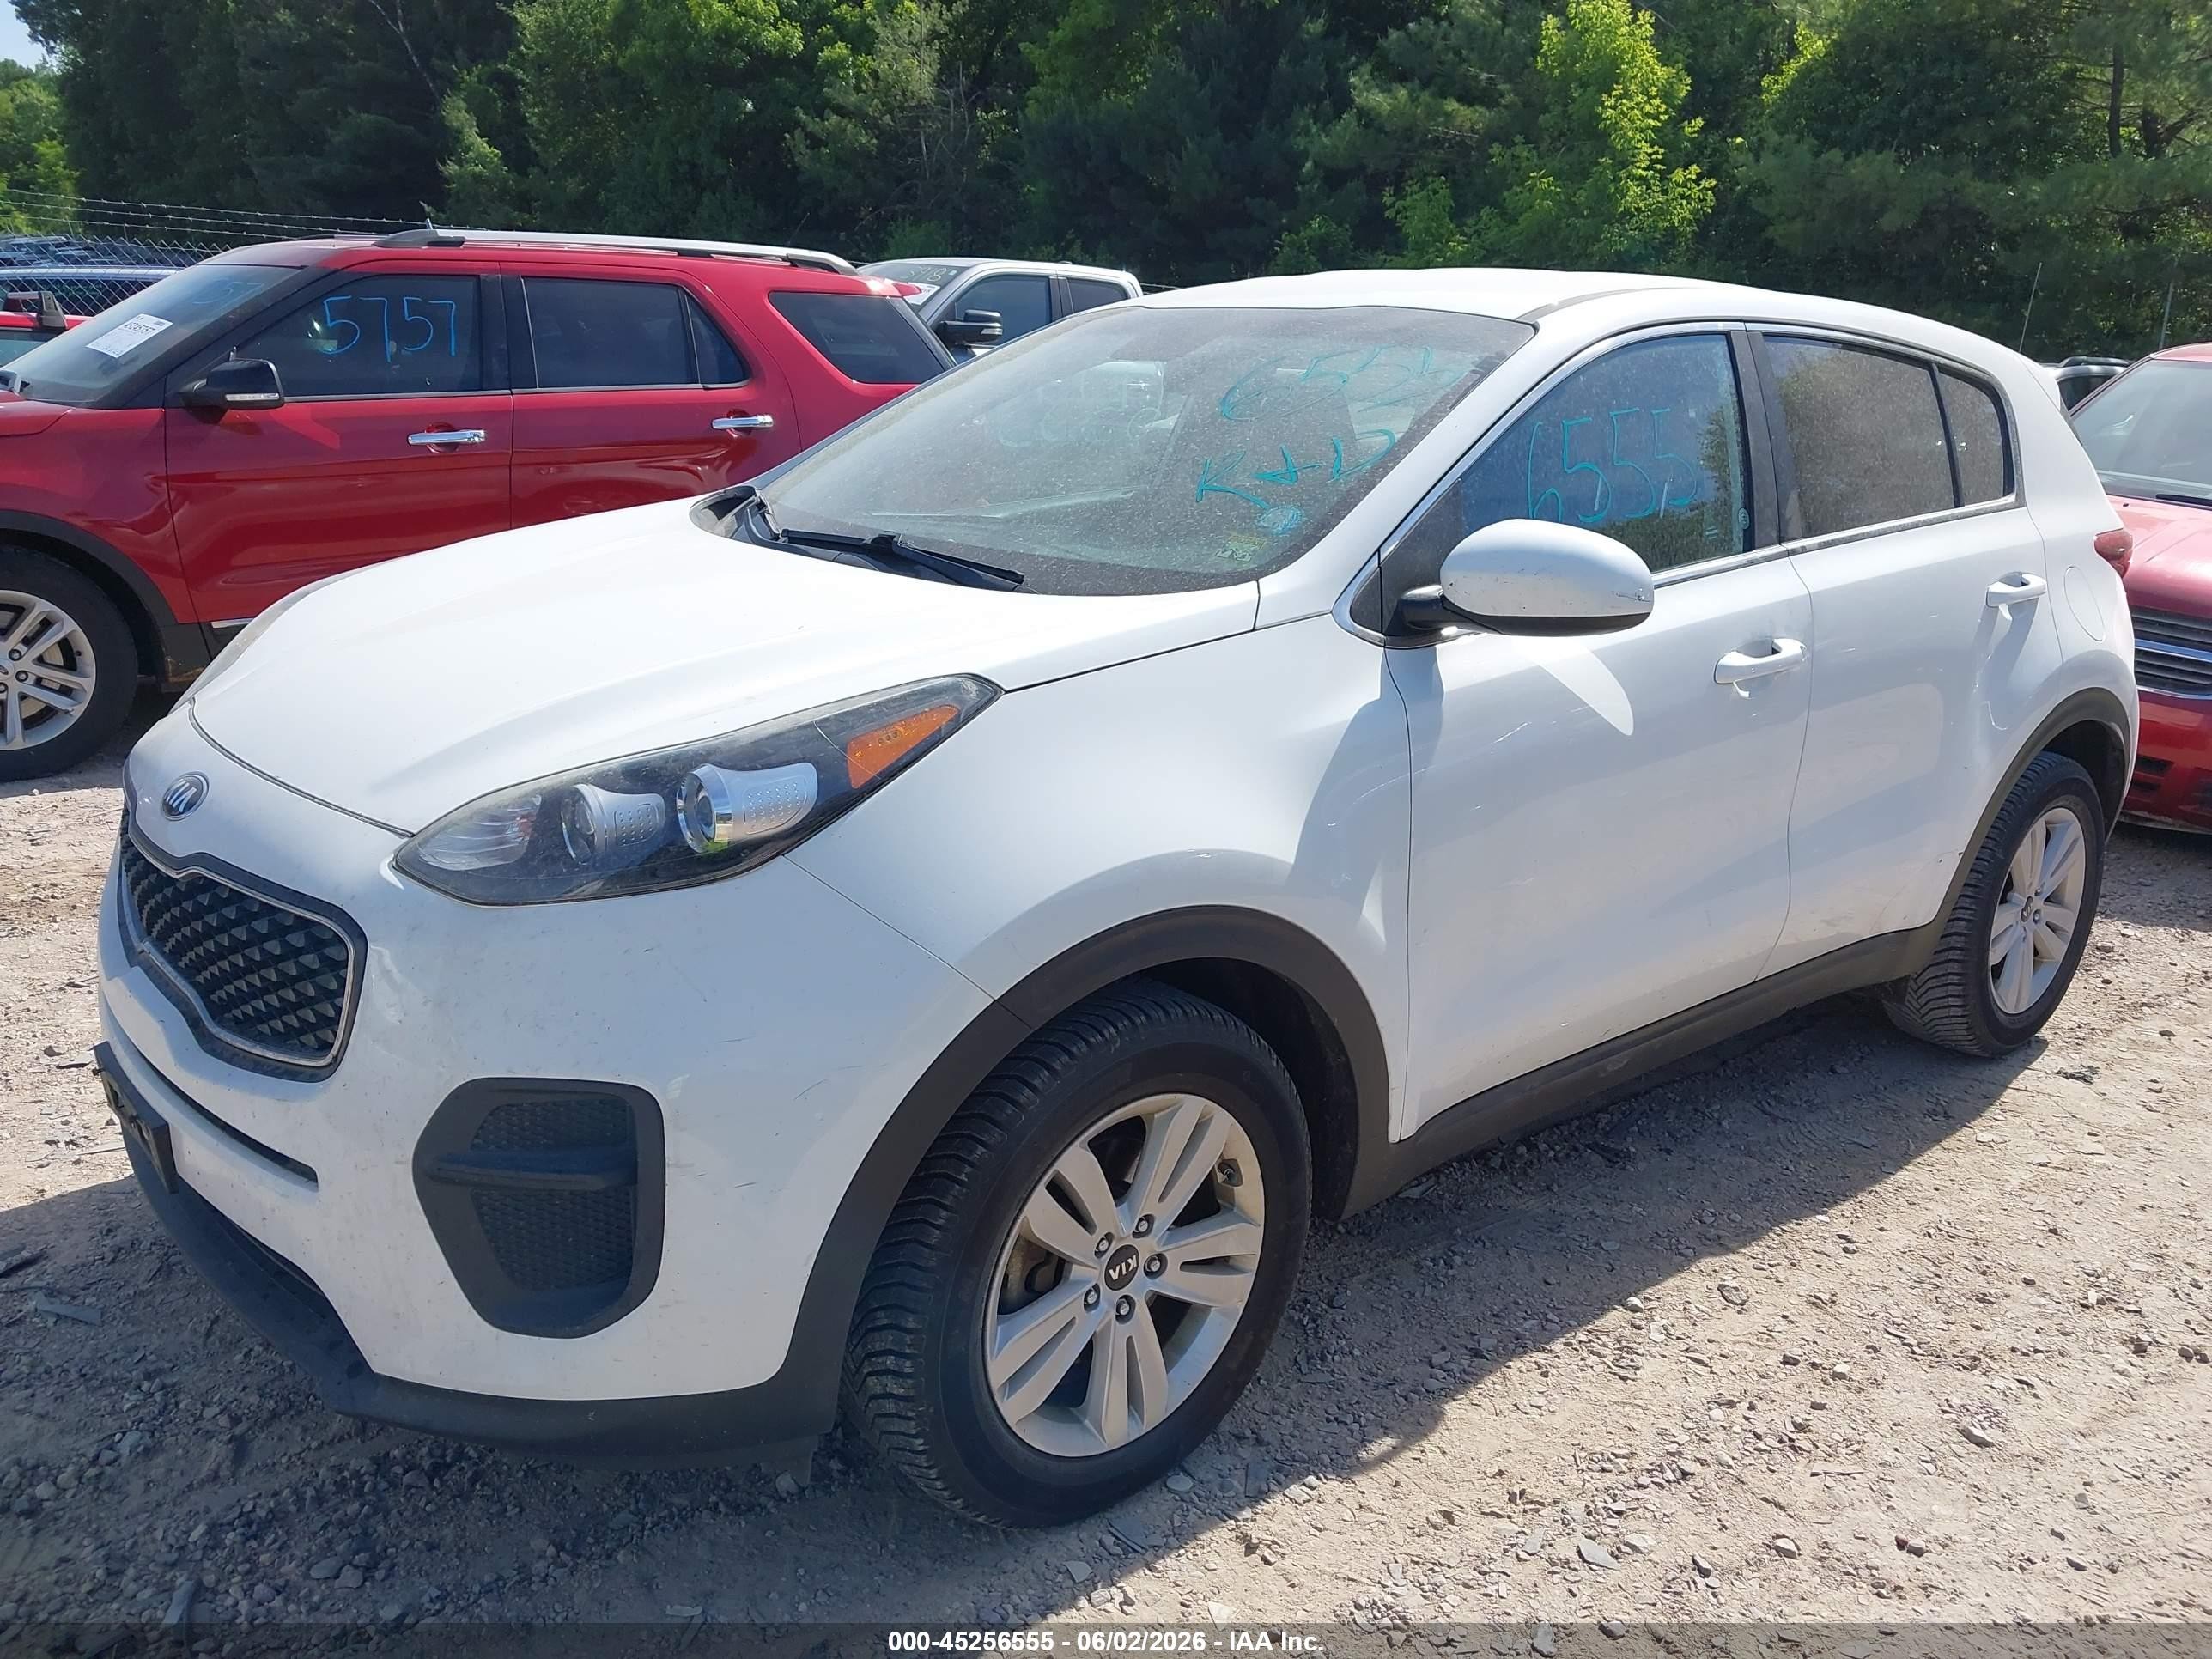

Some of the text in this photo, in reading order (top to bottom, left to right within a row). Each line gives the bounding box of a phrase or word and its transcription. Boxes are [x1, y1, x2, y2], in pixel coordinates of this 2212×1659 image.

[319, 295, 456, 363] 5757
[1527, 407, 1698, 523] 6555
[1109, 1255, 1137, 1280] KIA
